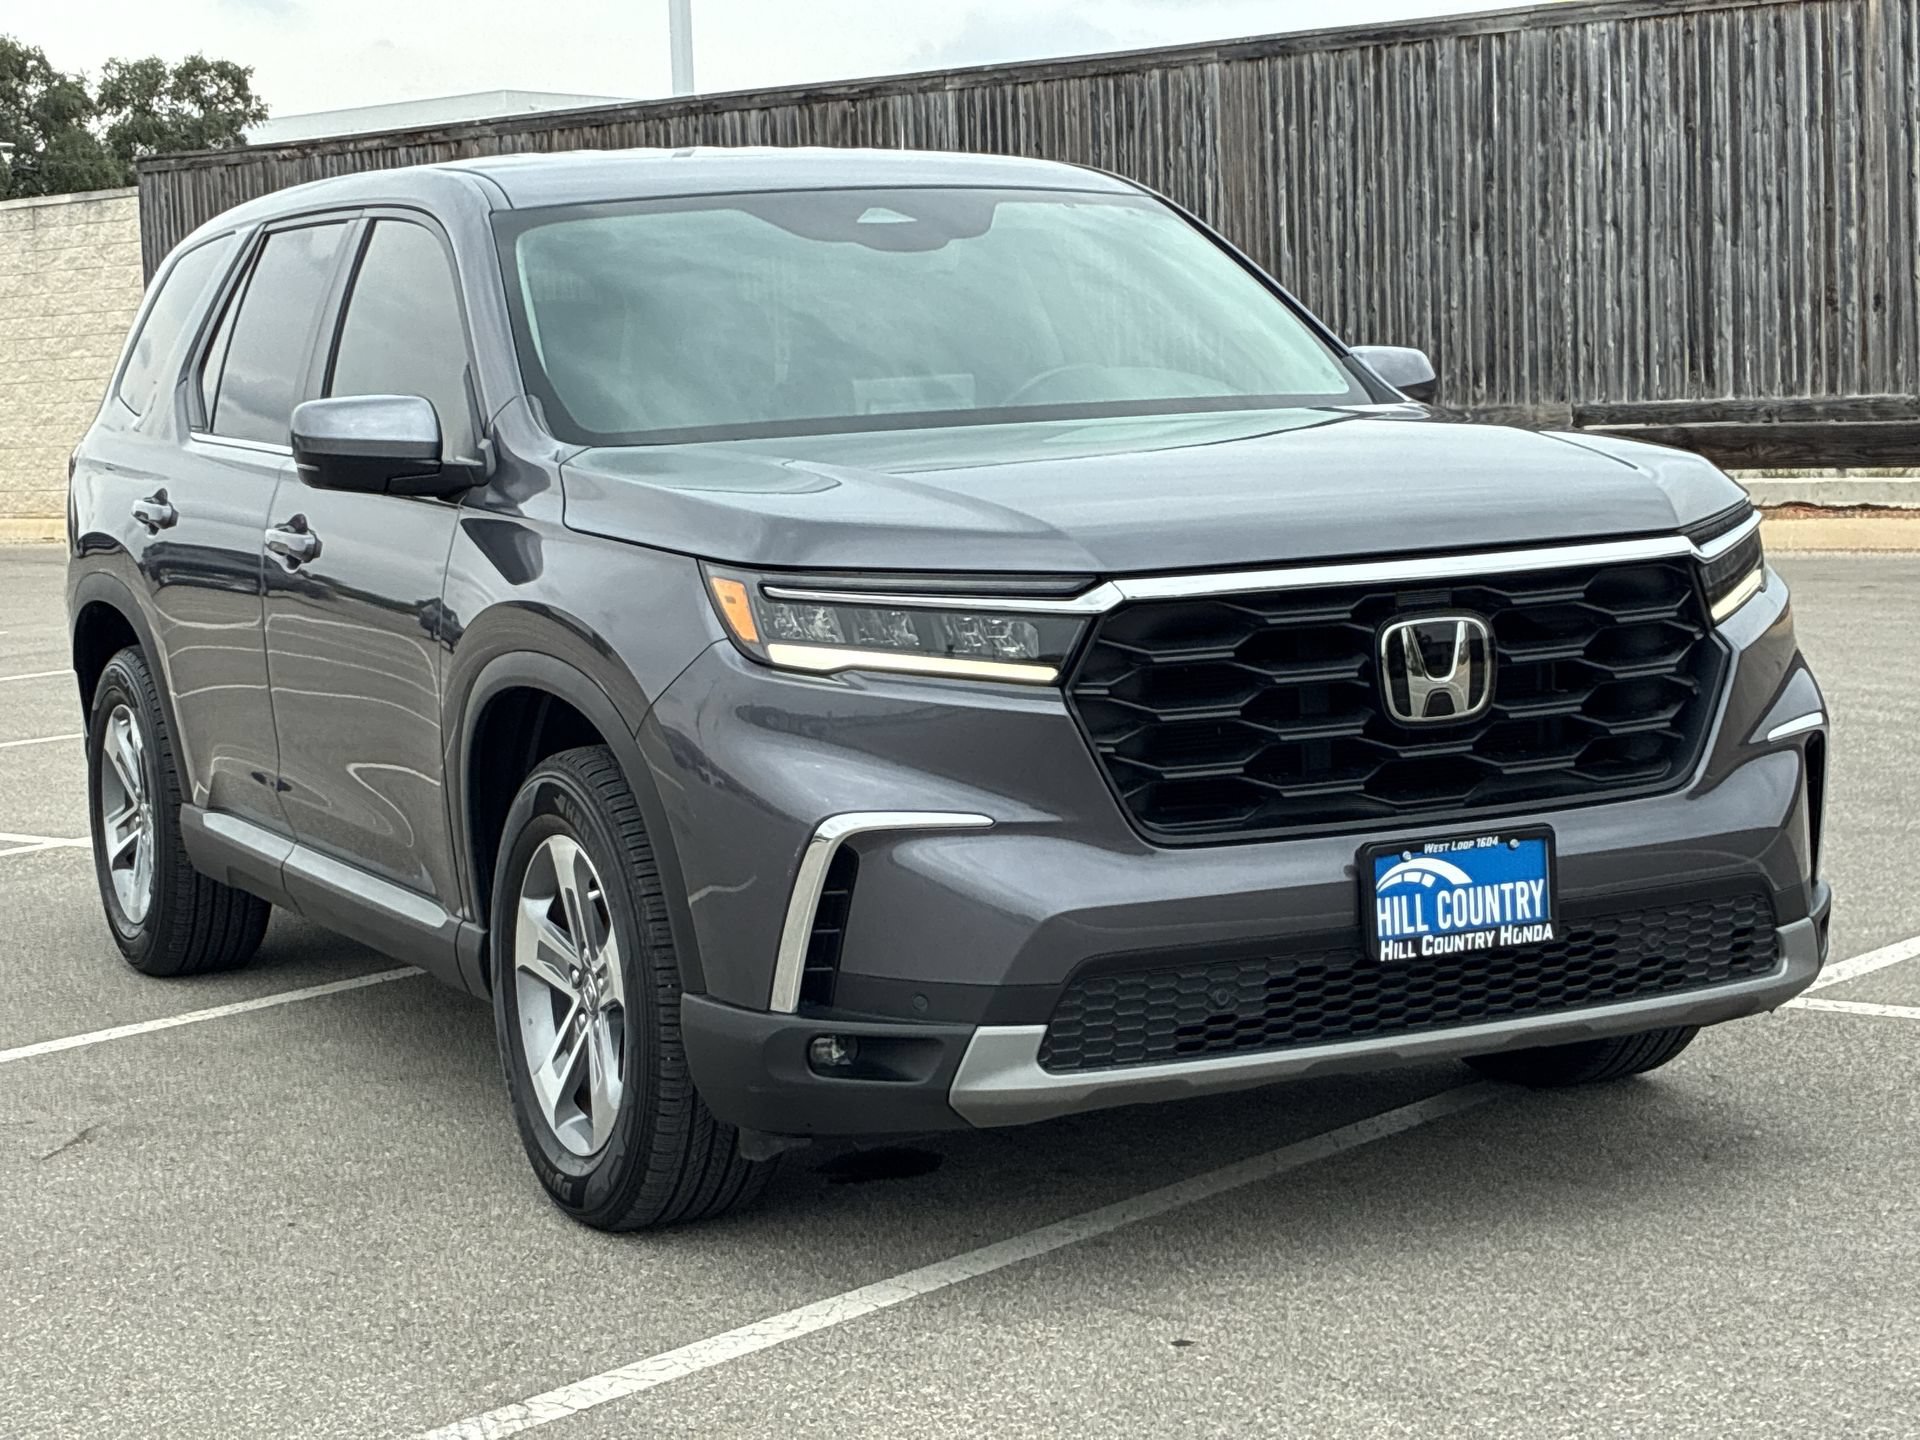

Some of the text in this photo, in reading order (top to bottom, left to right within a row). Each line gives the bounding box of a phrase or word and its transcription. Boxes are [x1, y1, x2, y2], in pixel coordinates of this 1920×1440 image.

[1476, 836, 1499, 848] 1604
[1376, 878, 1545, 937] HILL COUNTRY
[1380, 923, 1554, 962] HILL COUNTRY HONDA
